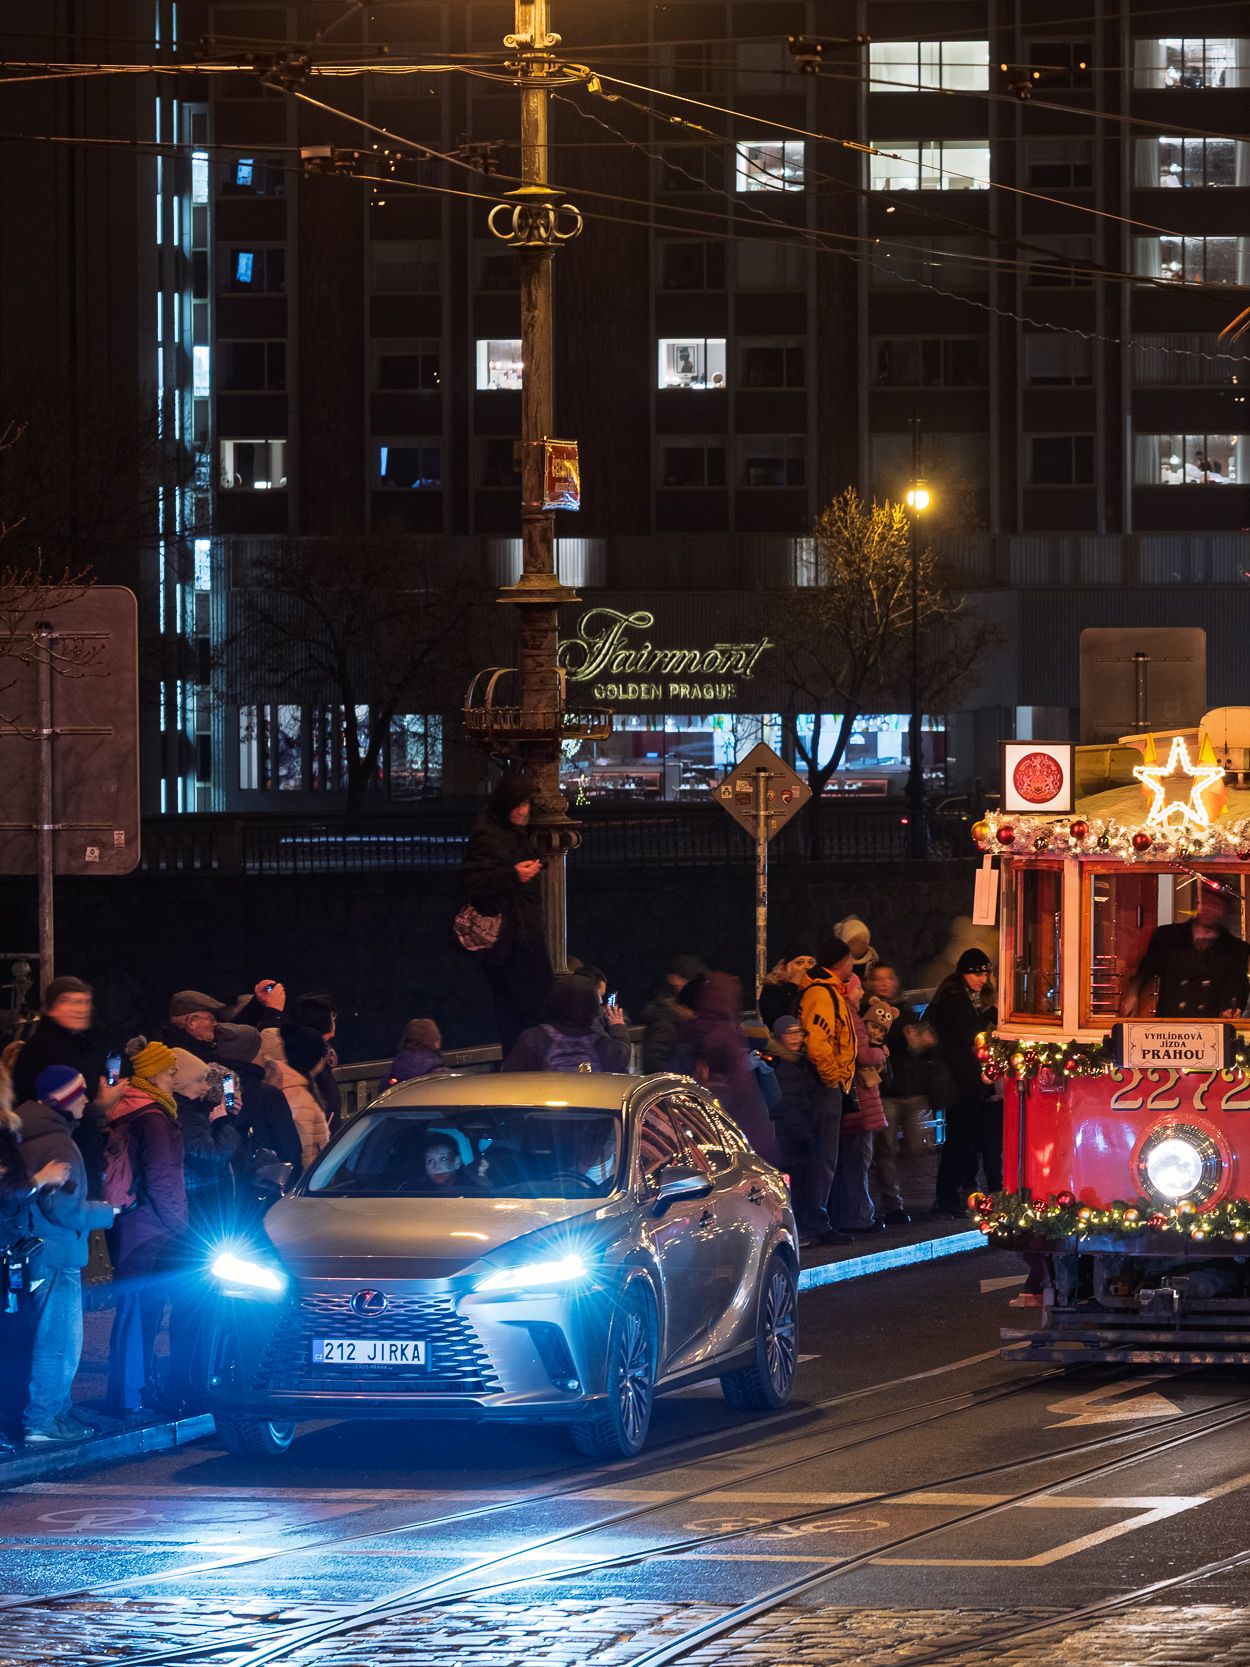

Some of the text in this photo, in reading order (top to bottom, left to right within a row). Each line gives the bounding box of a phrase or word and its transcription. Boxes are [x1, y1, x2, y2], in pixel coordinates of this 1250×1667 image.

[557, 608, 775, 681] Fairmont
[593, 684, 737, 699] GOLDEN PRAGUE
[1145, 1031, 1202, 1040] VYHLÍDKOVÁ
[1160, 1040, 1186, 1048] JÍZDA
[1142, 1050, 1204, 1059] PRAHOU
[325, 1343, 356, 1360] 212
[367, 1343, 421, 1361] JIRKA
